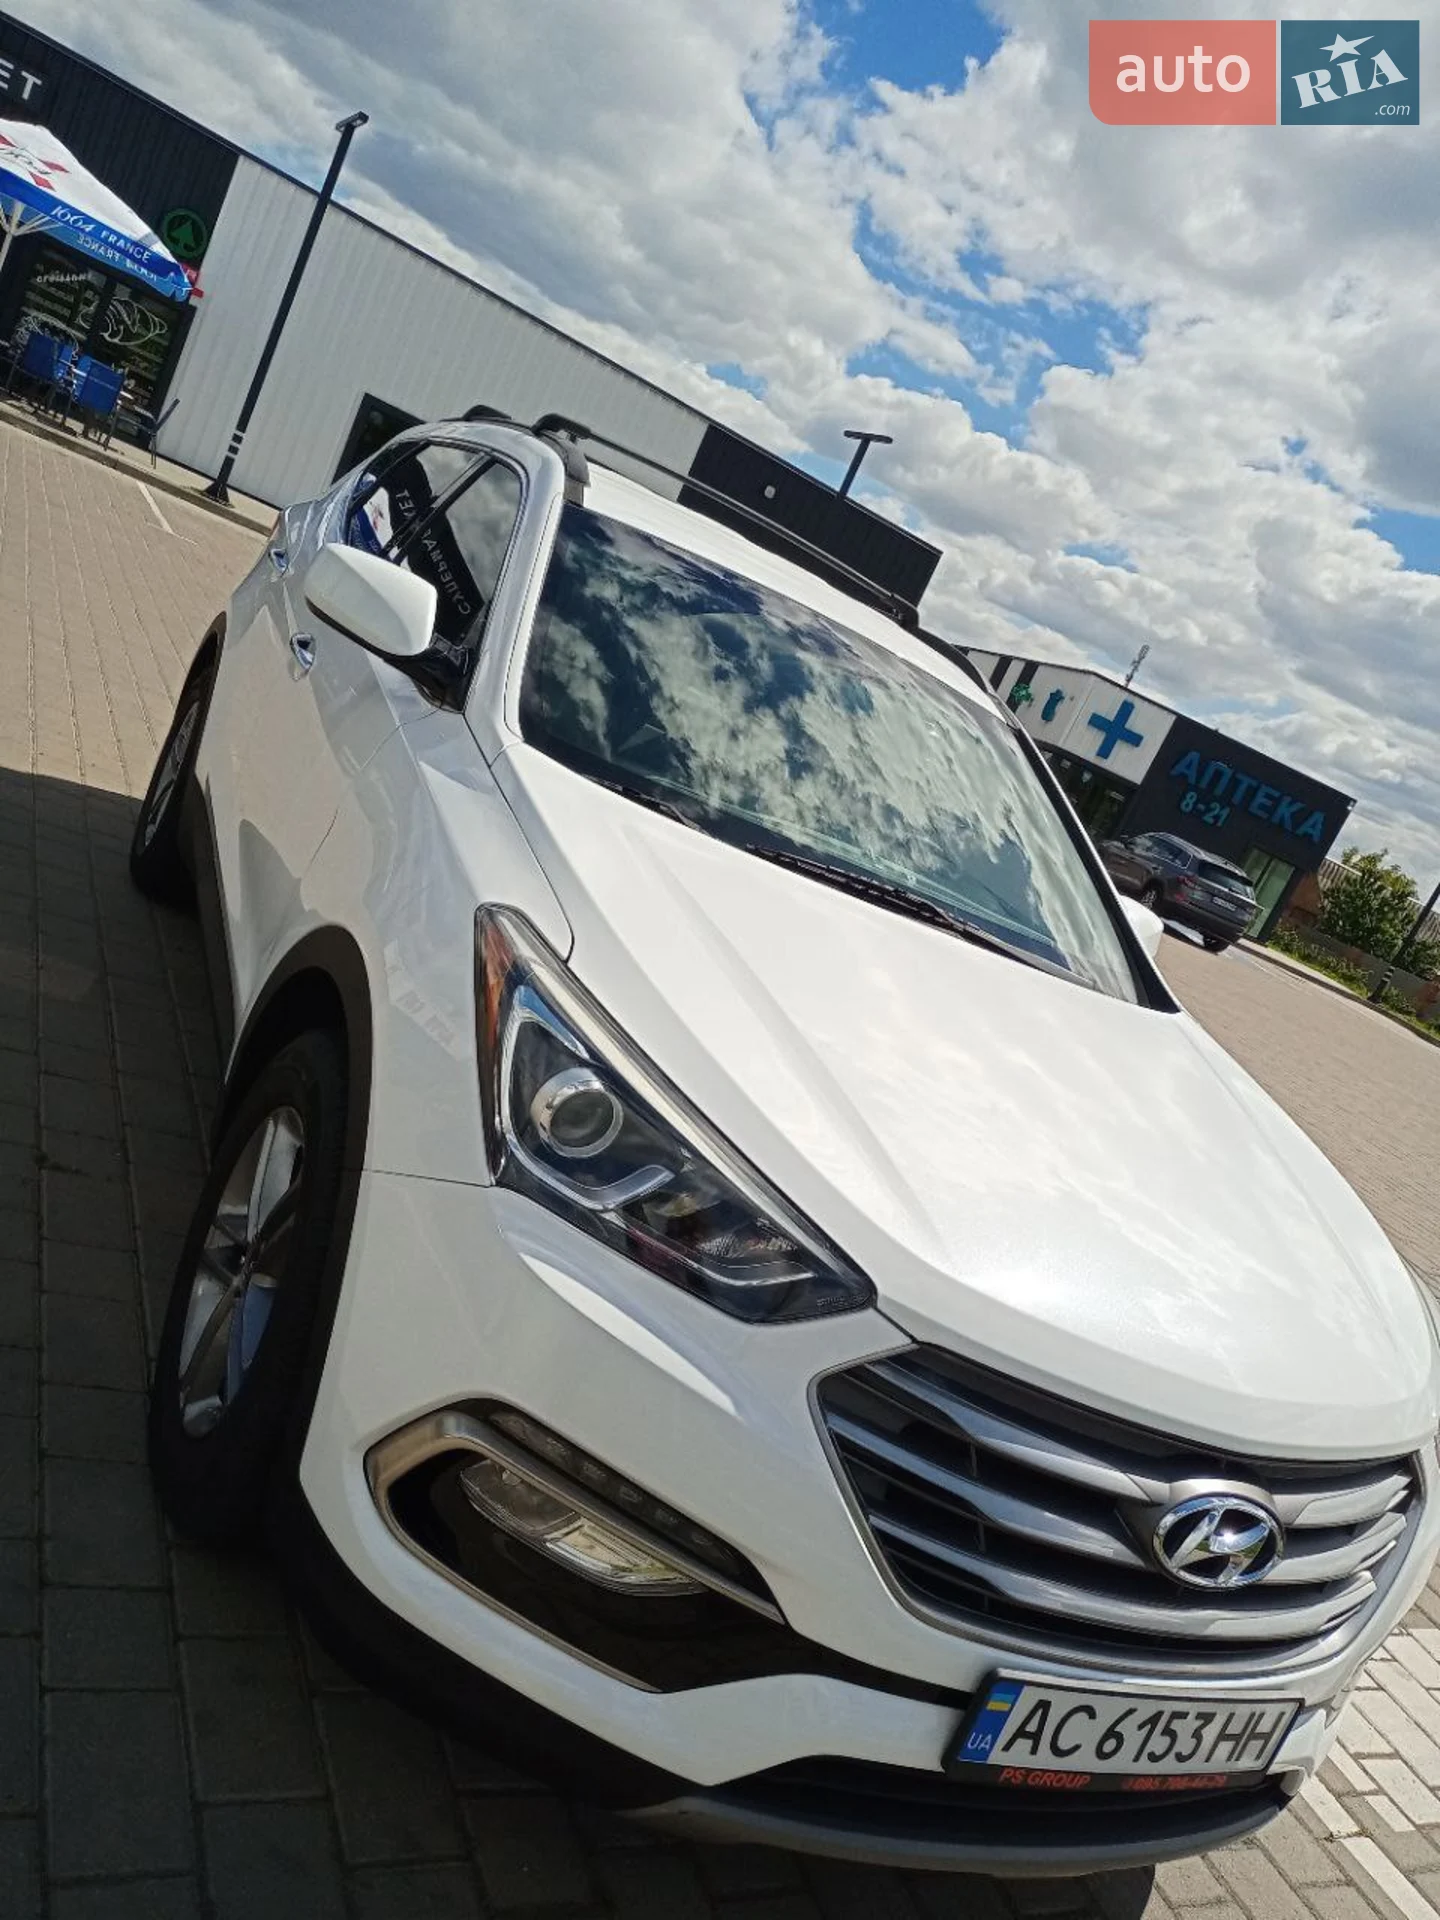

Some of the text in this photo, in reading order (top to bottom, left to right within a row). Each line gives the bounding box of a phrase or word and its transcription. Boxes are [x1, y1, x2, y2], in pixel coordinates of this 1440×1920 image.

[100, 229, 152, 264] FRANCE
[1170, 750, 1325, 843] АПТЕКА
[1180, 791, 1231, 829] 8-21
[967, 1732, 991, 1751] UA
[999, 1768, 1091, 1789] PS GROUP
